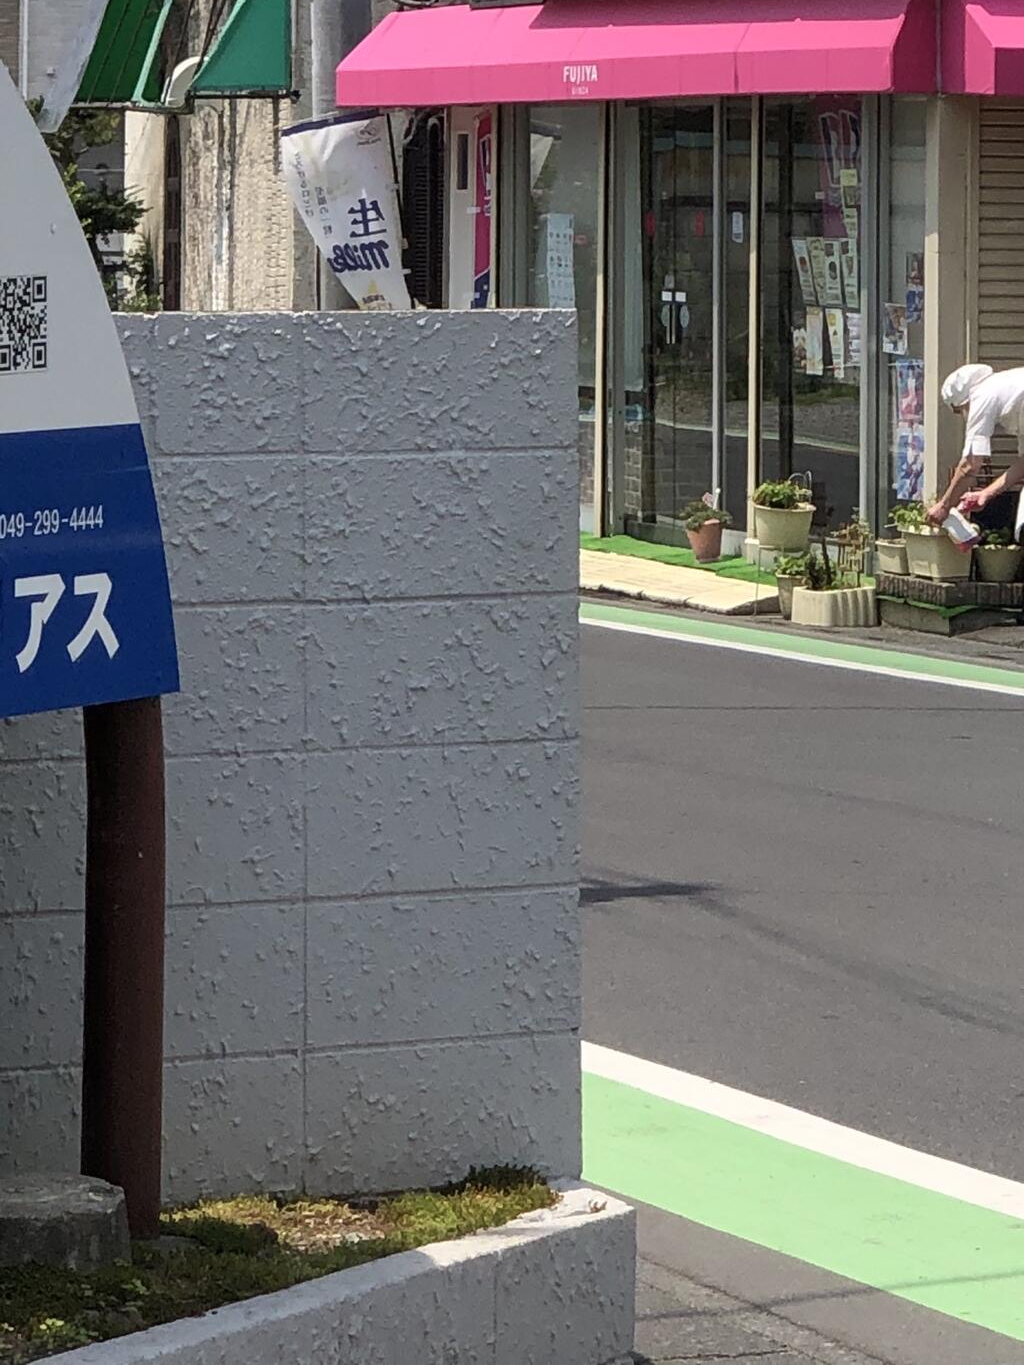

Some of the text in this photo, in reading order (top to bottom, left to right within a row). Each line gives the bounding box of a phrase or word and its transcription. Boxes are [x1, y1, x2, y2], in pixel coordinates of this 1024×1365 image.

[562, 64, 599, 85] FUJIYA
[0, 504, 104, 540] 049-299-4444
[14, 573, 120, 674] アス
